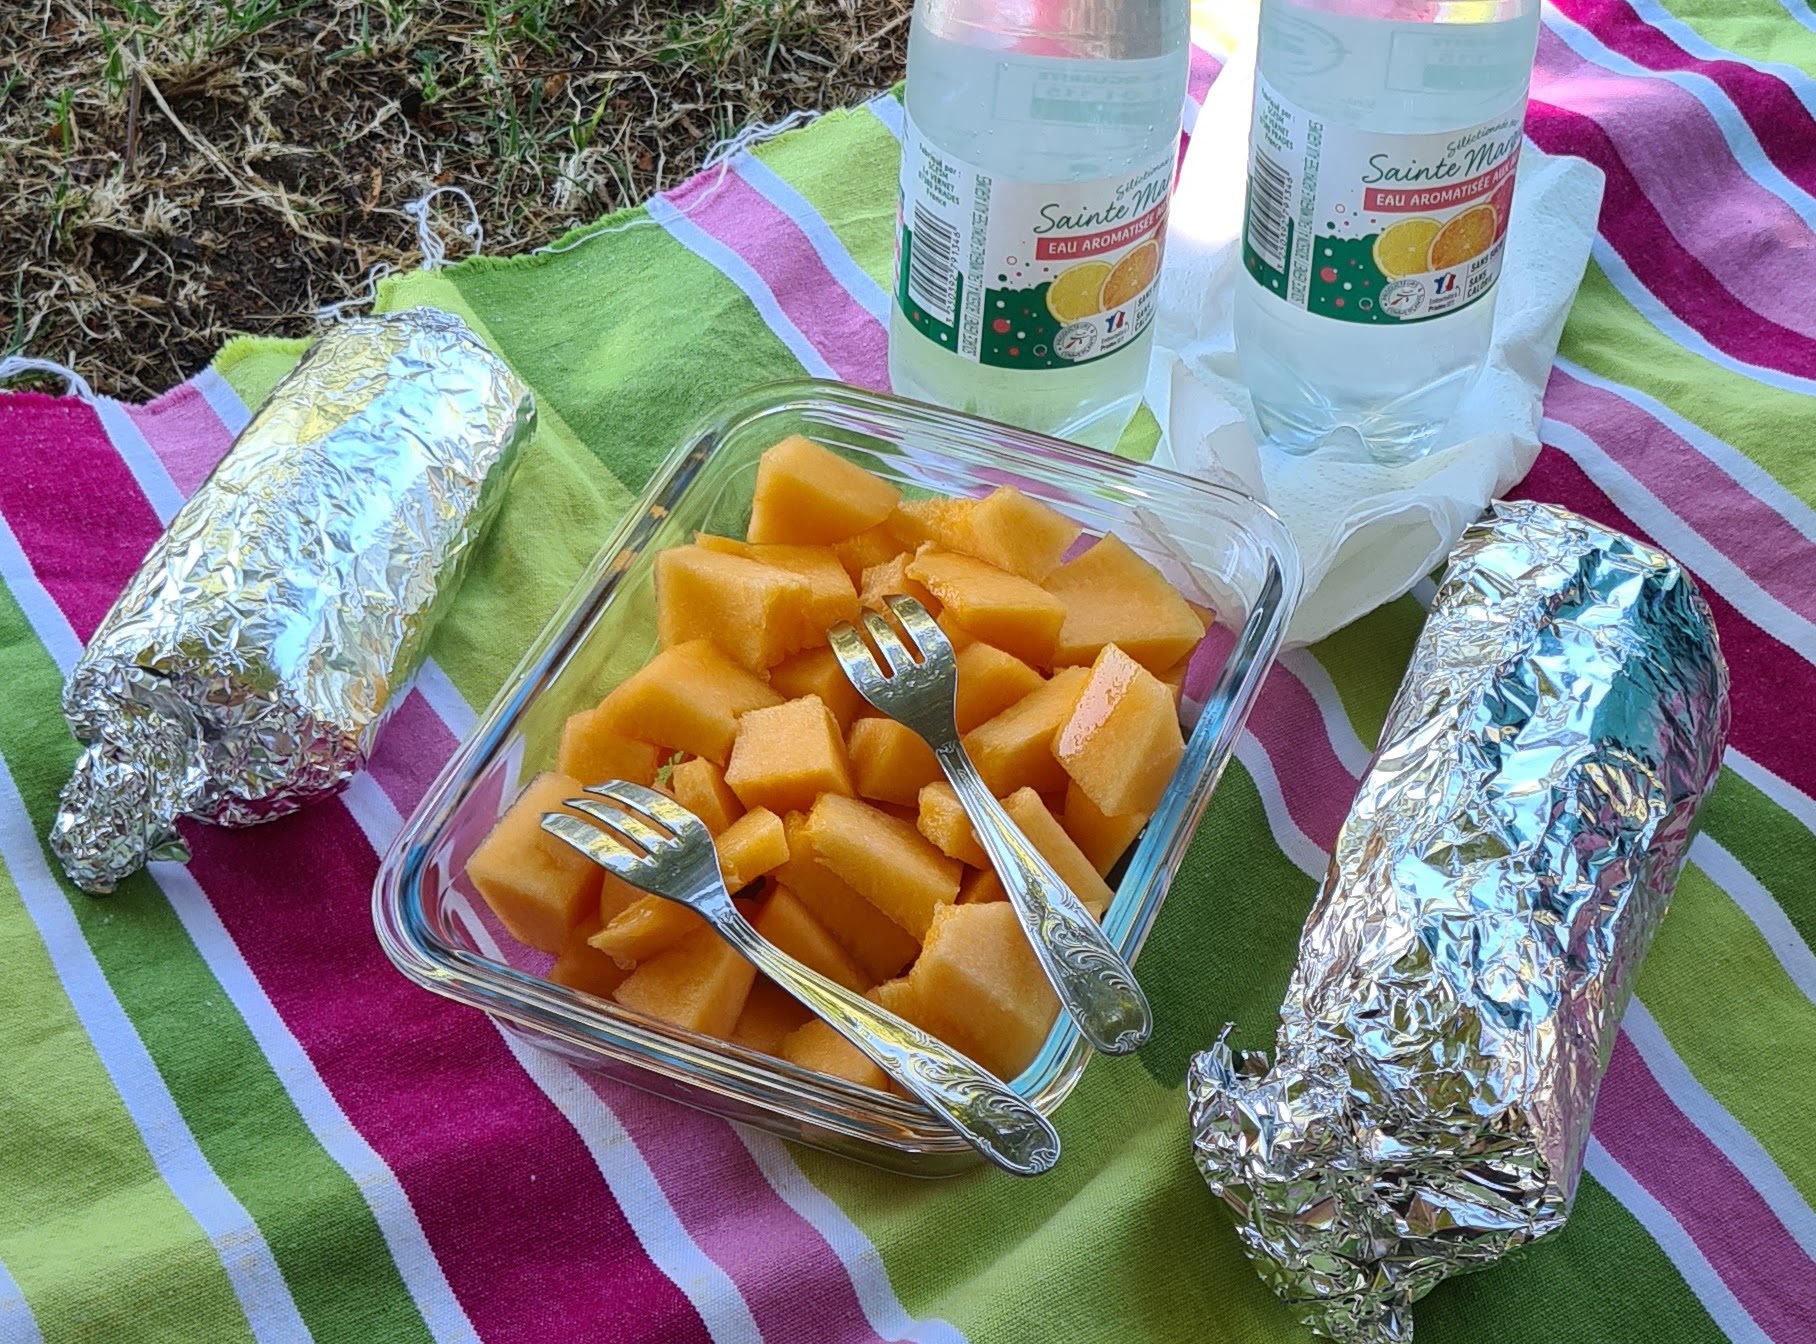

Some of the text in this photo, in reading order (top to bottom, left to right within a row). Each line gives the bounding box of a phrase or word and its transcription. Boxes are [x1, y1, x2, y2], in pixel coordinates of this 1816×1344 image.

[1362, 153, 1461, 184] Sainte
[1376, 193, 1405, 207] EAU
[1410, 176, 1490, 205] AROMATISÉE
[1033, 201, 1130, 234] Sainte
[1048, 241, 1077, 255] EAU
[1082, 215, 1153, 252] AROMATISÉE
[1469, 268, 1488, 287] SANS
[1471, 254, 1489, 272] SANS
